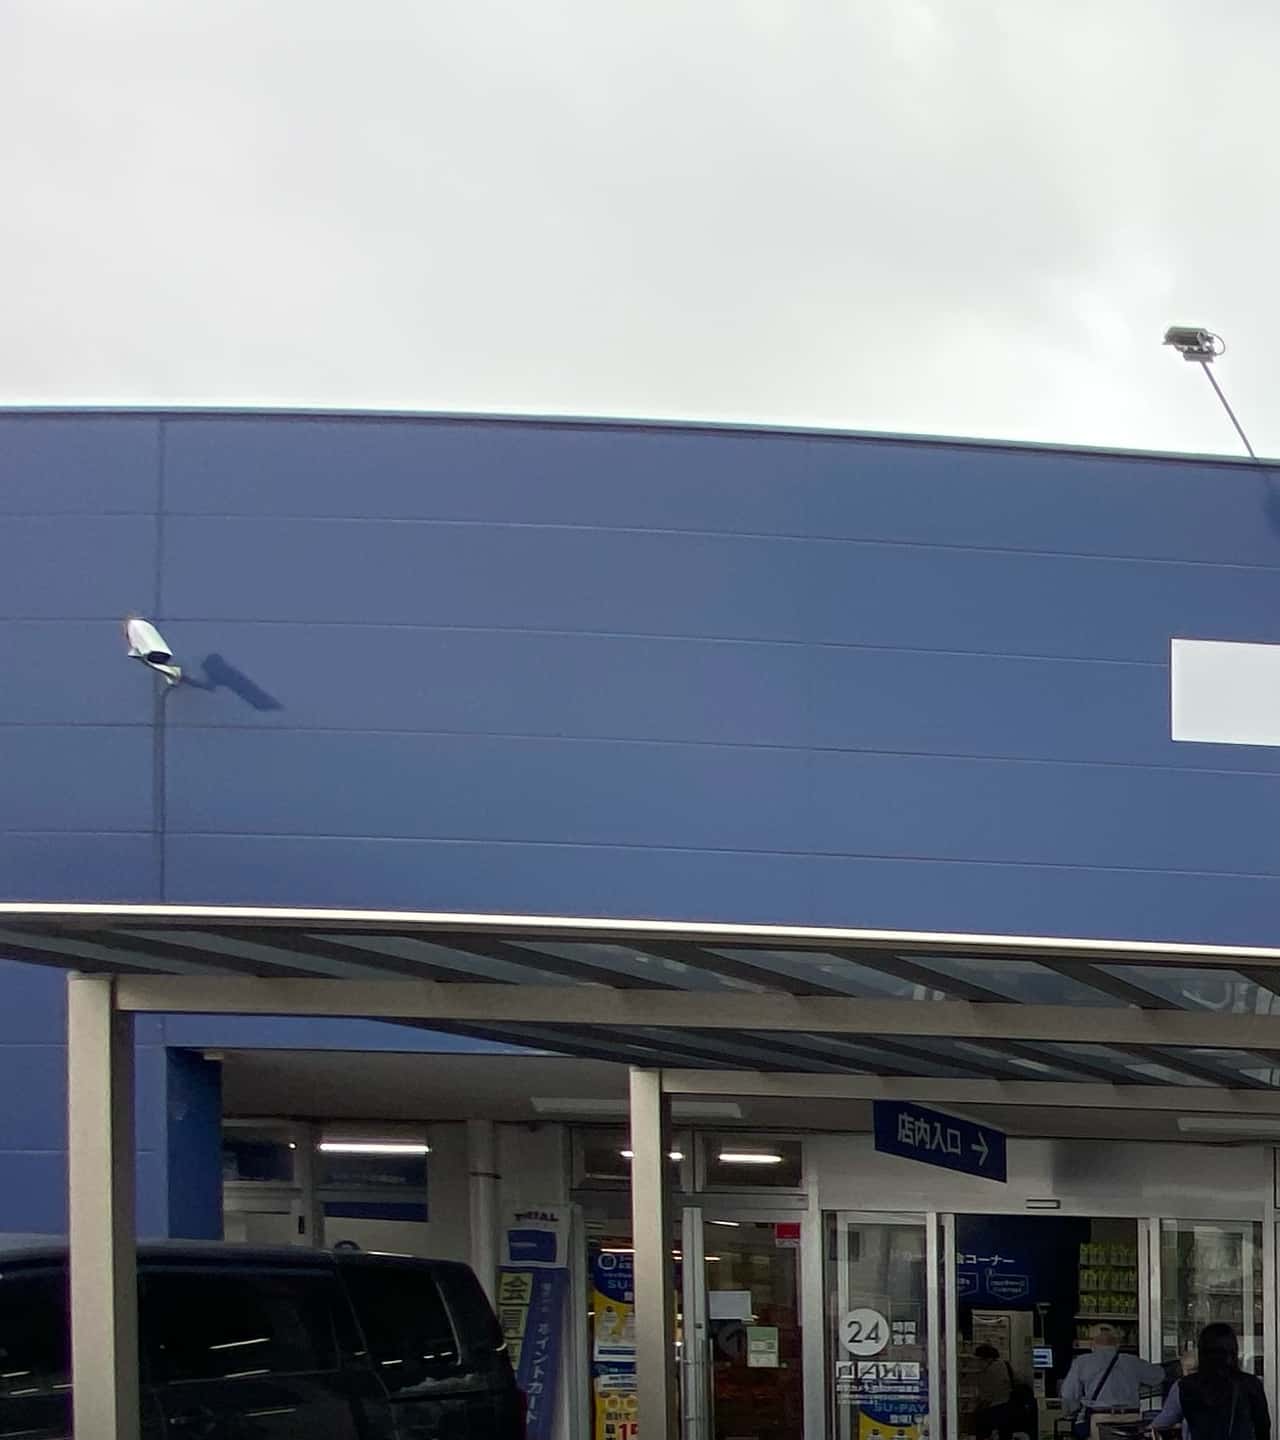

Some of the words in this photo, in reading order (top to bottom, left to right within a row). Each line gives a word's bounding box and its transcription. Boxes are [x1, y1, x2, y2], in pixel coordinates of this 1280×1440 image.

[896, 1112, 961, 1155] 店内入口
[846, 1320, 882, 1344] 24
